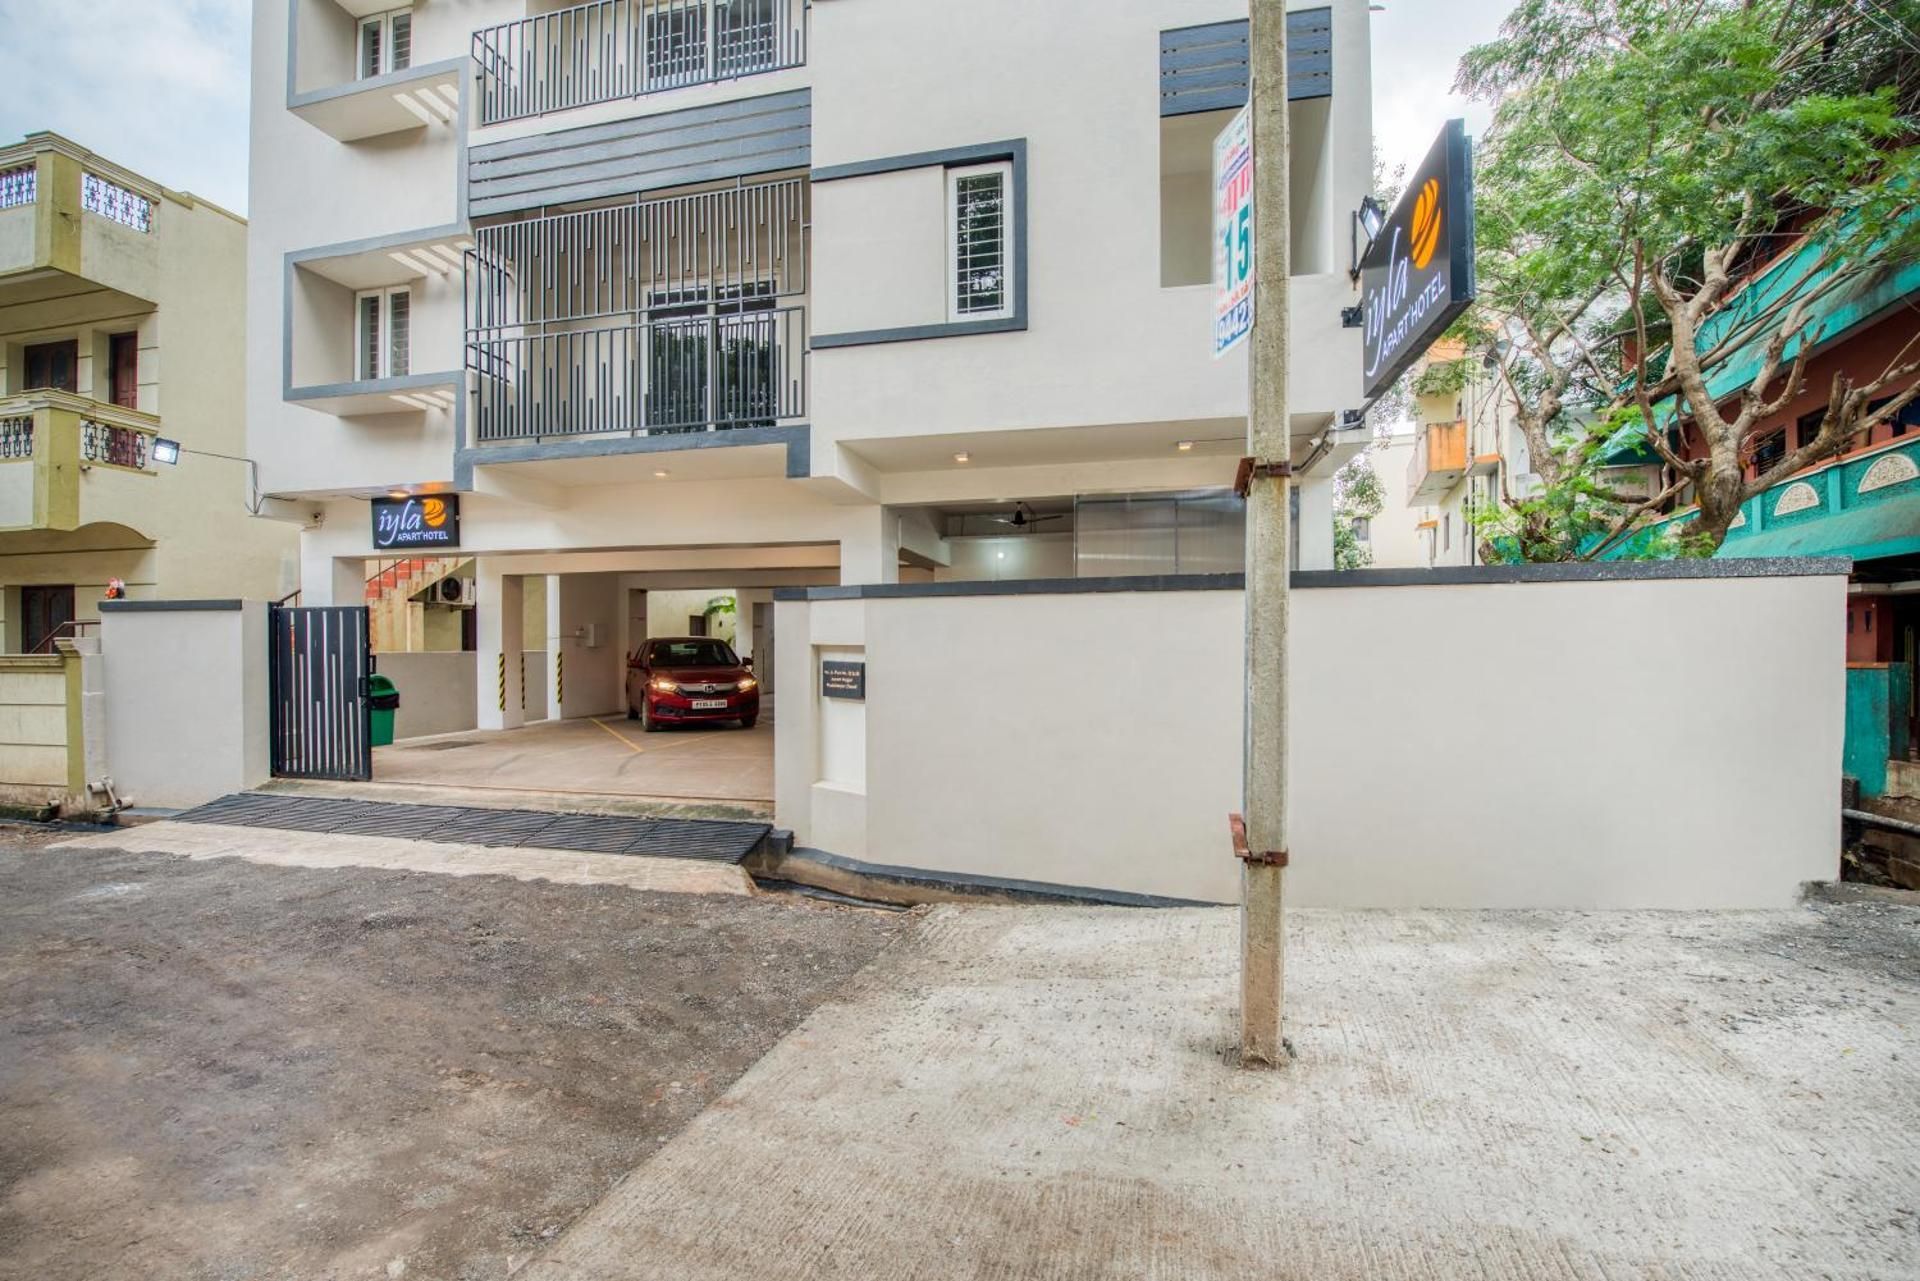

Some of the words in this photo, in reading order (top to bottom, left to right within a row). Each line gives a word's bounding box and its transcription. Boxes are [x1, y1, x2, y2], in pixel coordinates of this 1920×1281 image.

[1366, 227, 1408, 377] iyla
[1381, 271, 1446, 362] APART'HOTEL
[378, 499, 421, 545] iyla
[397, 530, 448, 541] APART'HOTEL
